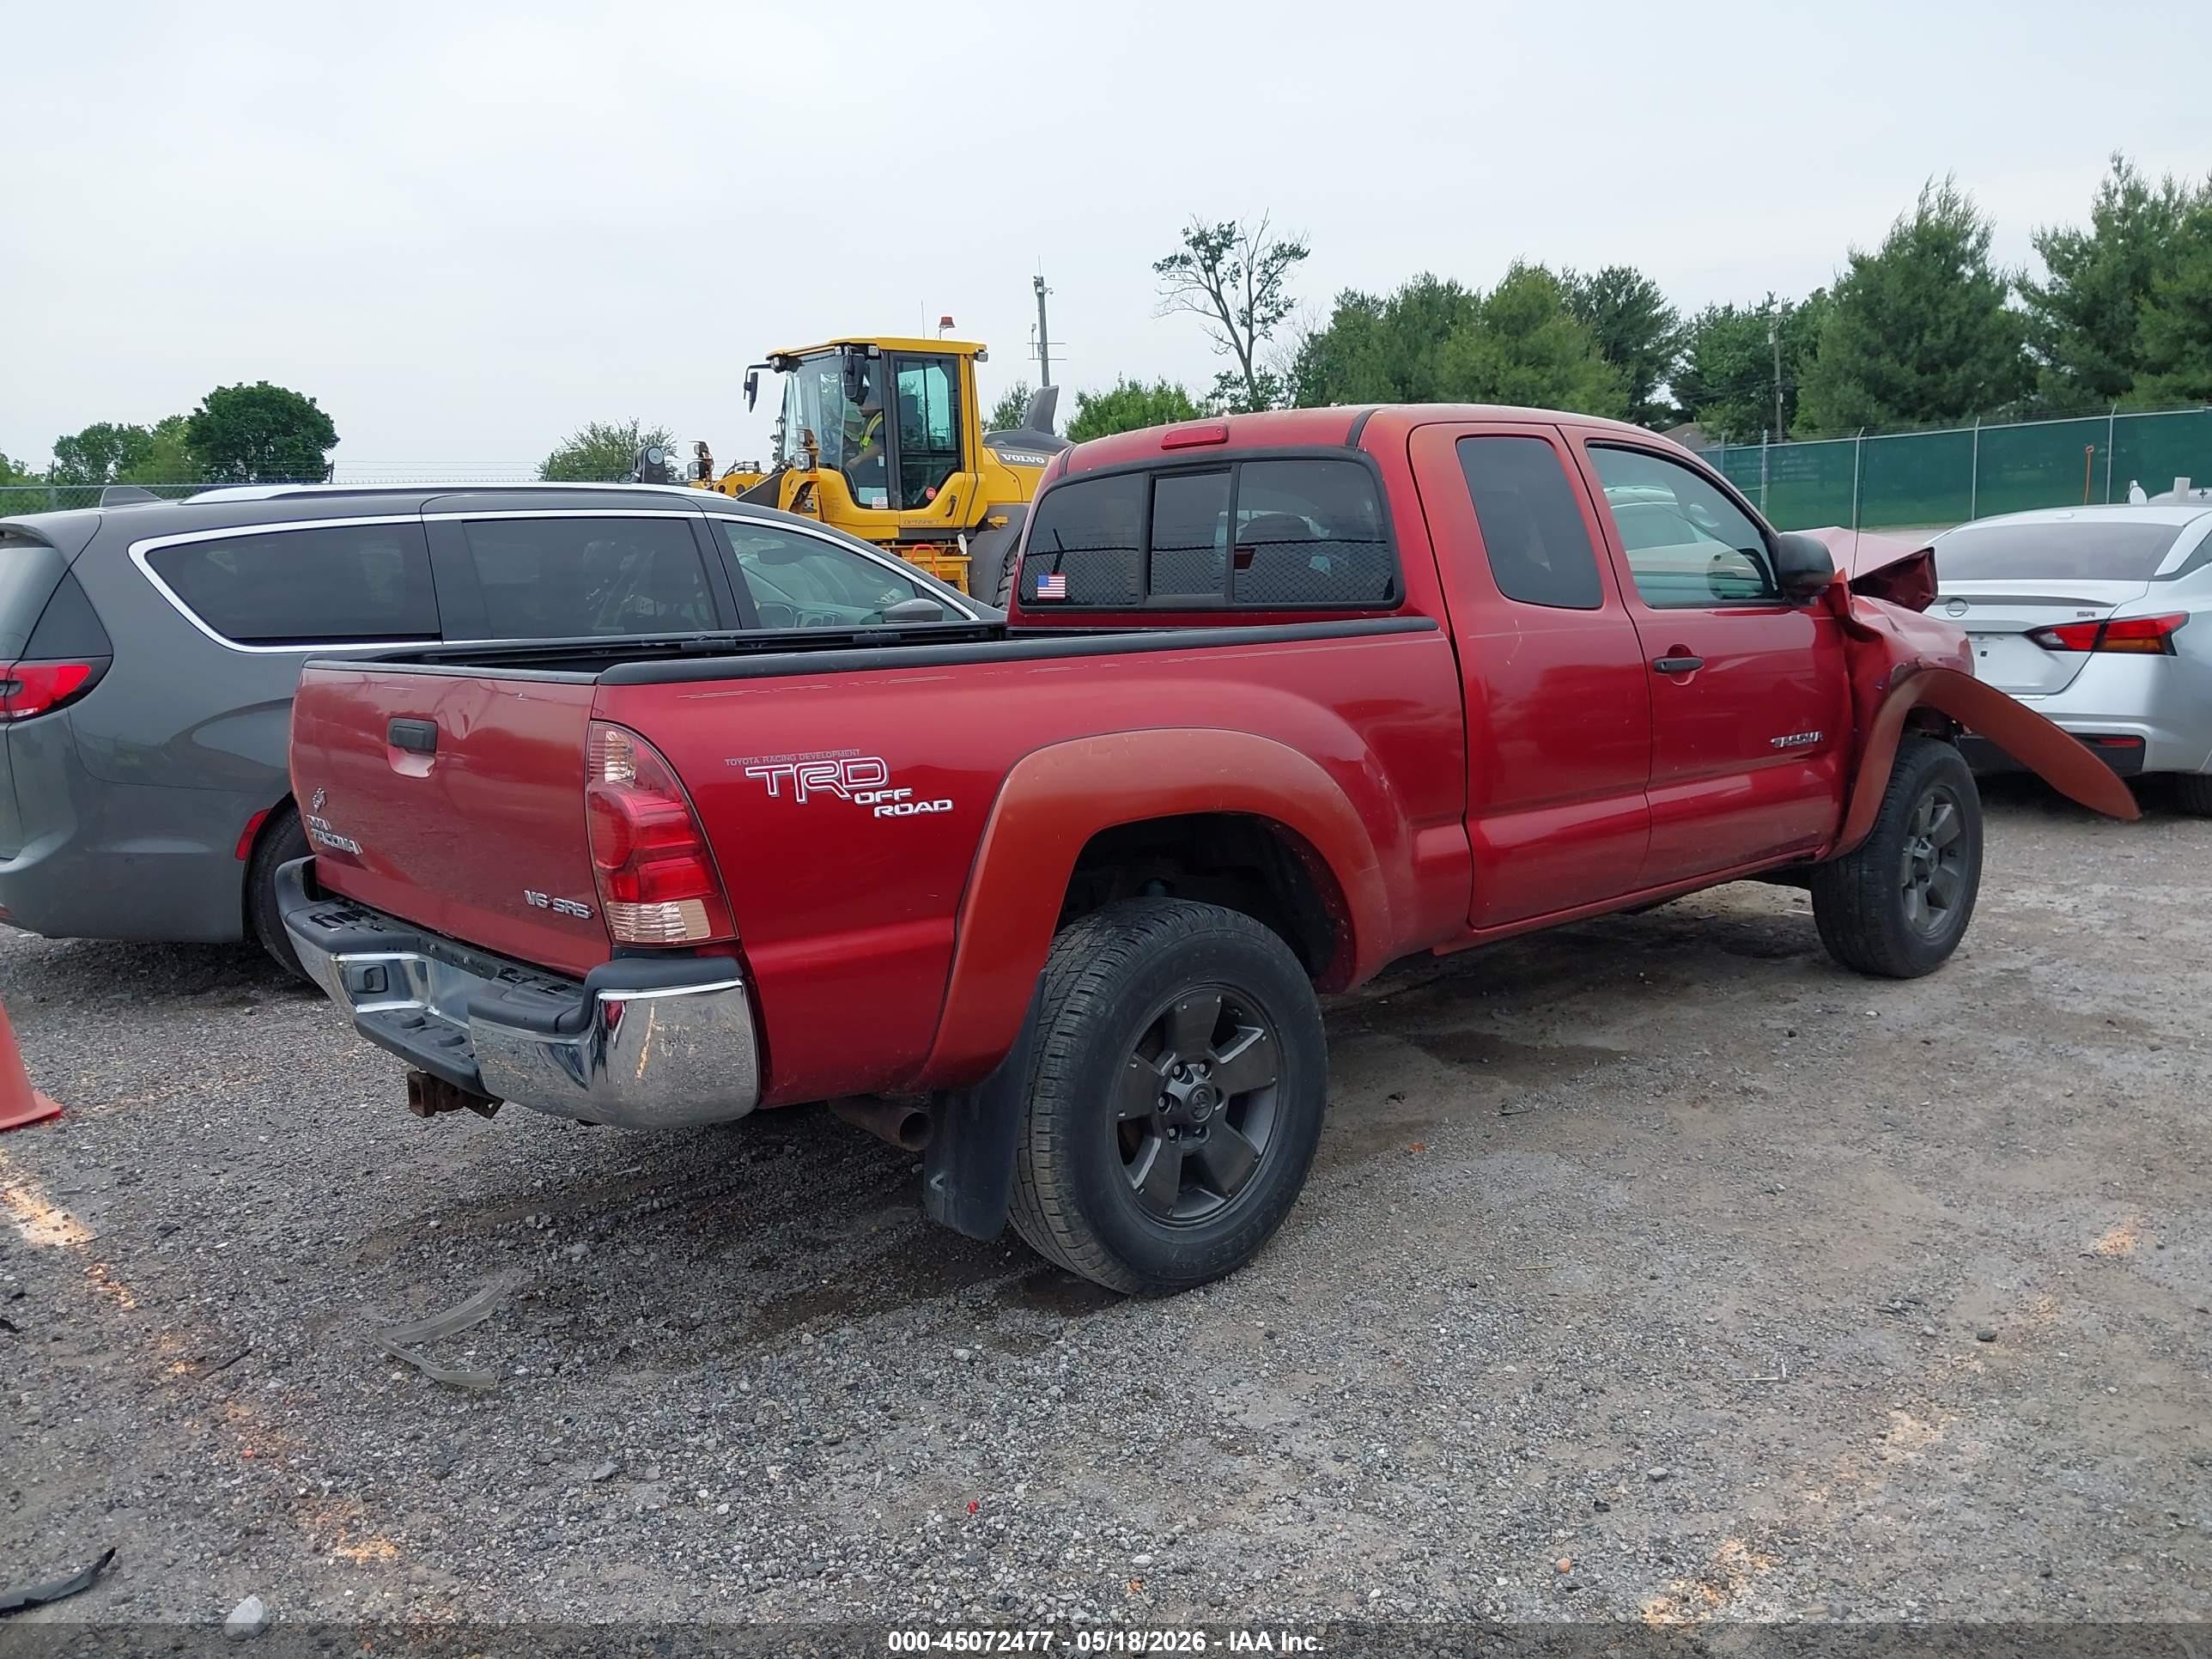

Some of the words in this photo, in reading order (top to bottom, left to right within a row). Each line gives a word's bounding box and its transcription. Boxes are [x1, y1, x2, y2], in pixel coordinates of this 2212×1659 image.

[1000, 453, 1045, 464] VOLVO
[724, 757, 760, 767] TOYOTA
[763, 753, 797, 763] RACING
[799, 749, 861, 762] DEVELOPMENT
[745, 757, 889, 804] TRD
[854, 787, 913, 805] OFF
[873, 799, 953, 818] ROAD
[523, 890, 549, 908] V6
[552, 897, 591, 920] SR5
